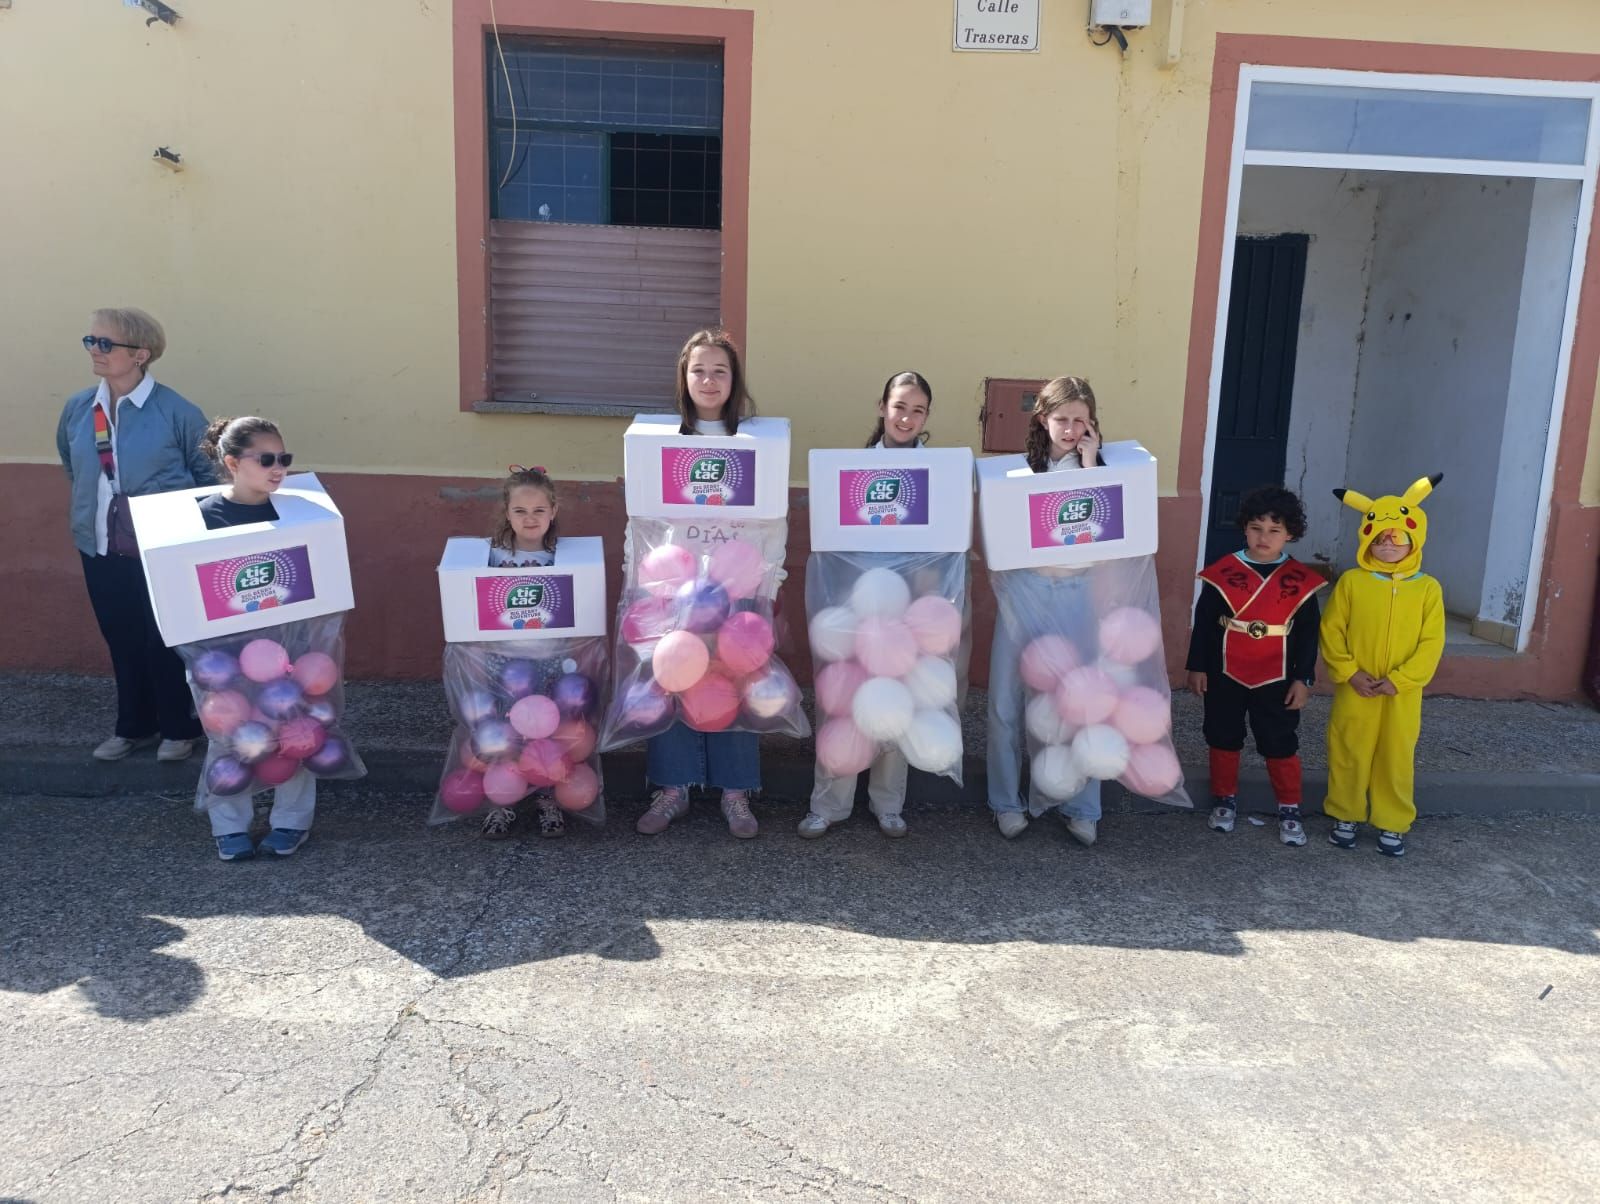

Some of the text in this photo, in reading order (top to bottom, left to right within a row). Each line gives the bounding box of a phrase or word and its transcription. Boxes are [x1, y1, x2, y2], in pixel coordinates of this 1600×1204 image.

[977, 0, 1019, 13] Calle
[964, 27, 1029, 45] Traseras
[701, 461, 720, 471] tic
[695, 470, 719, 480] tac
[876, 481, 895, 492] tic
[870, 490, 894, 500] tac
[1068, 501, 1088, 512] tic
[1062, 510, 1087, 521] tac
[245, 565, 270, 579] tic
[240, 575, 269, 588] tac
[516, 587, 539, 598] tic
[511, 596, 537, 606] tac
